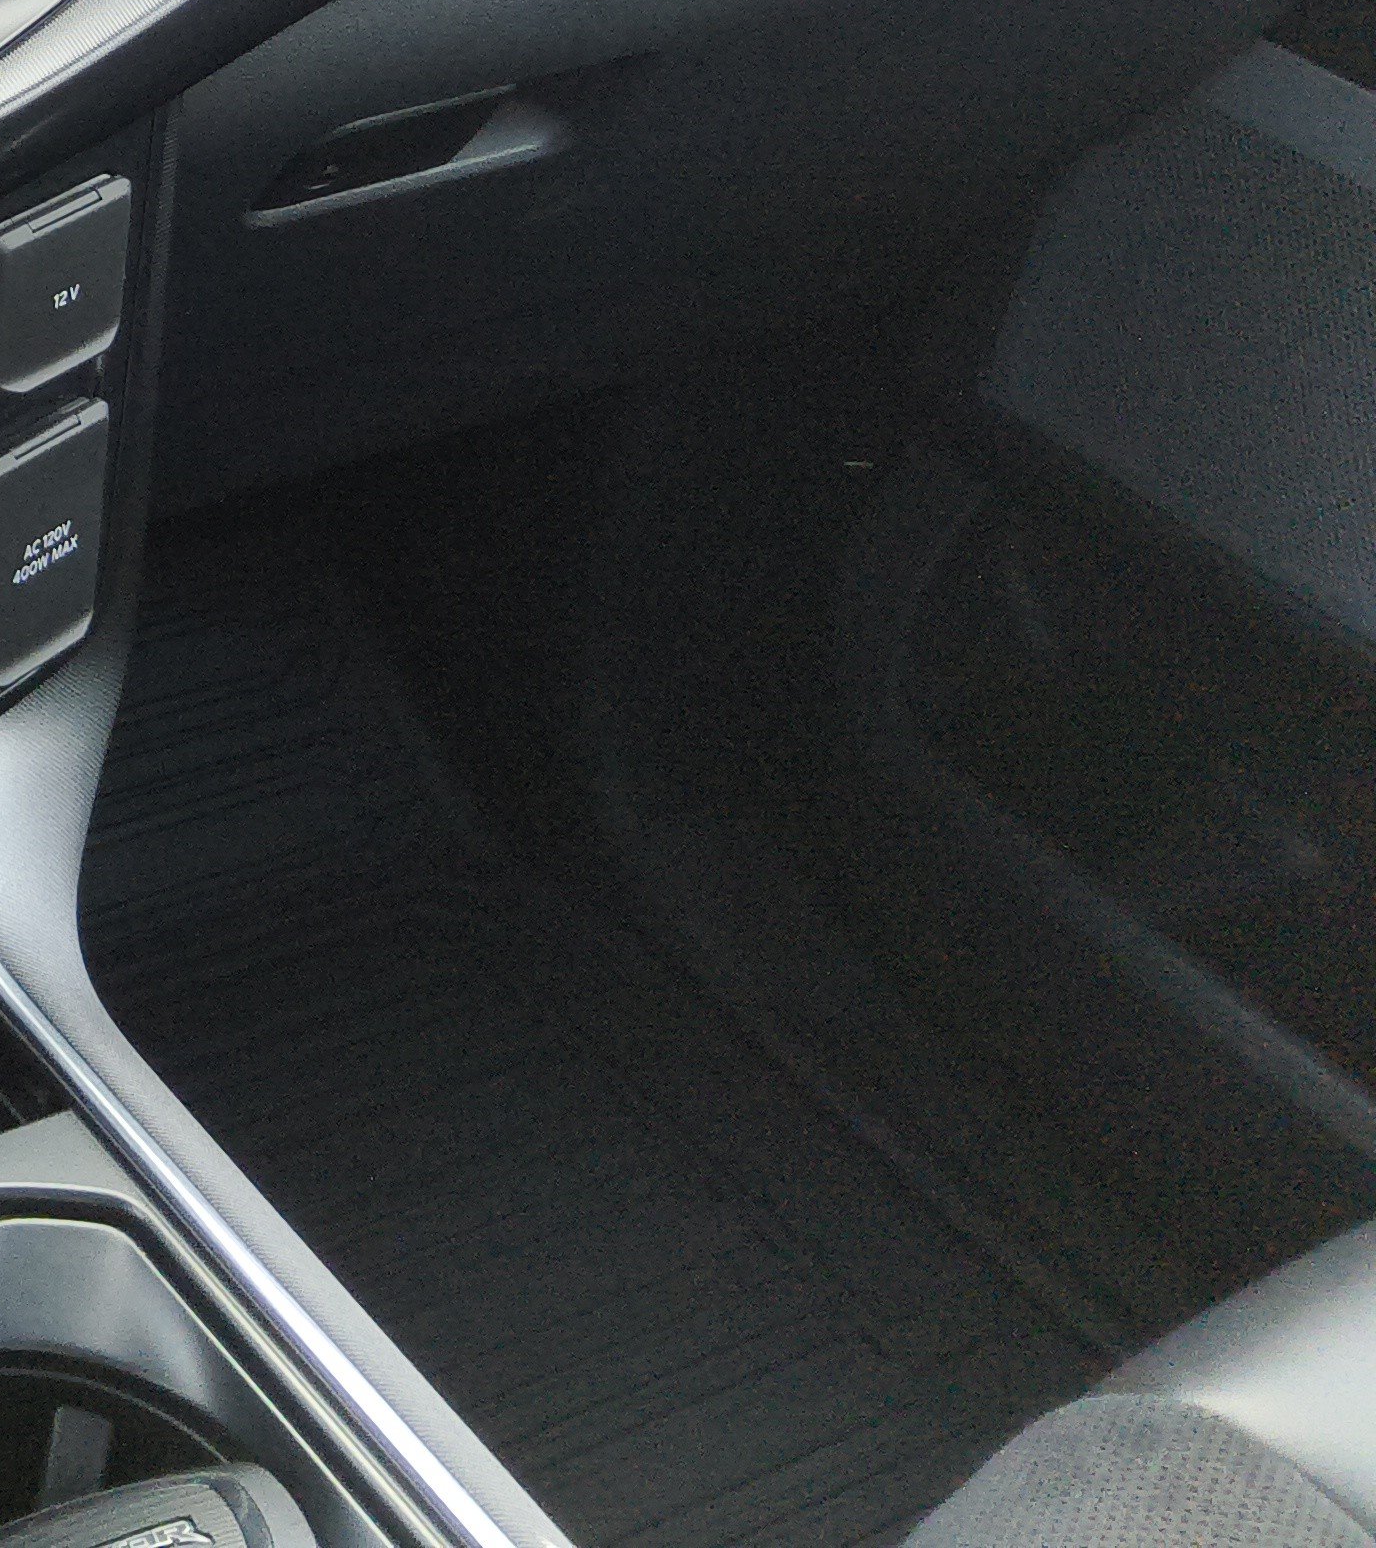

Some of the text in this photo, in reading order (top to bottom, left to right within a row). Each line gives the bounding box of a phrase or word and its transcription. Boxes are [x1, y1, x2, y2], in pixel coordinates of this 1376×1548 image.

[12, 533, 79, 584] 400W MAX
[23, 519, 72, 561] AC 120V
